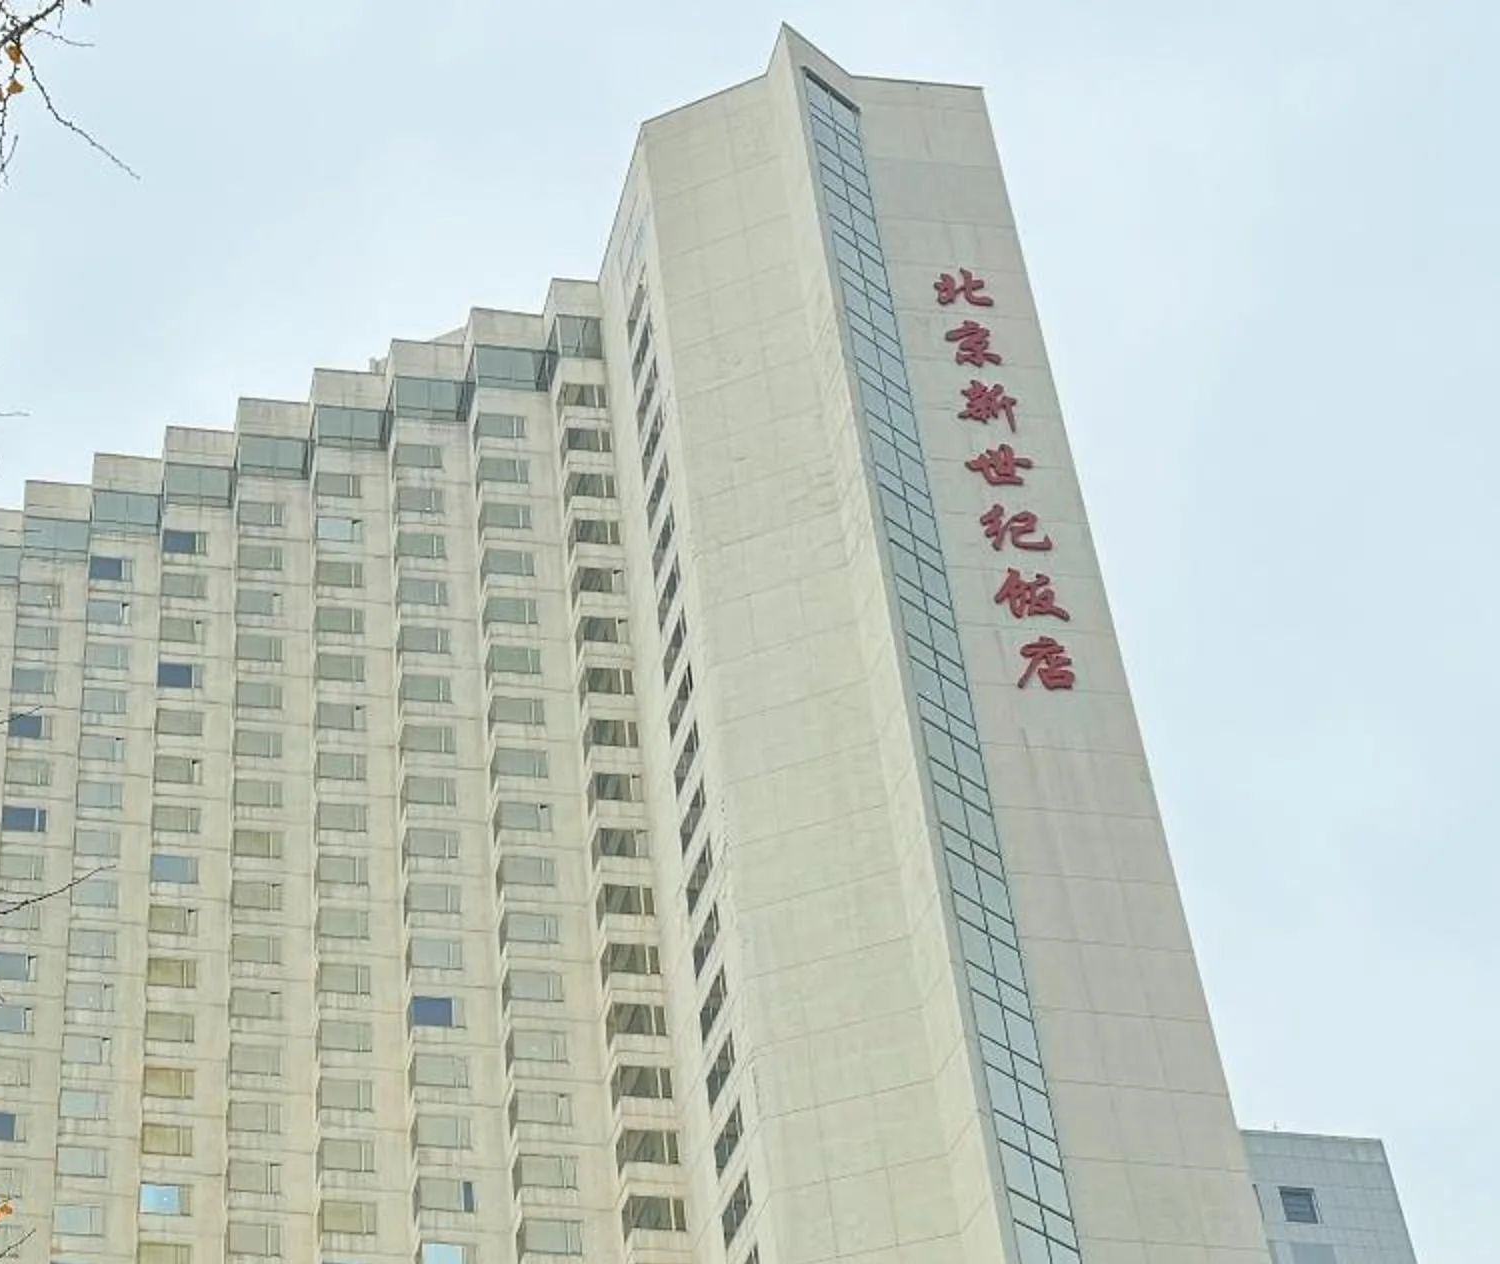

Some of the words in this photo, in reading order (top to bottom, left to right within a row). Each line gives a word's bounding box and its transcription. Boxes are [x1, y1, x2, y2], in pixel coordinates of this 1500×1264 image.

[933, 268, 1075, 690] 北京新世纪饭店
